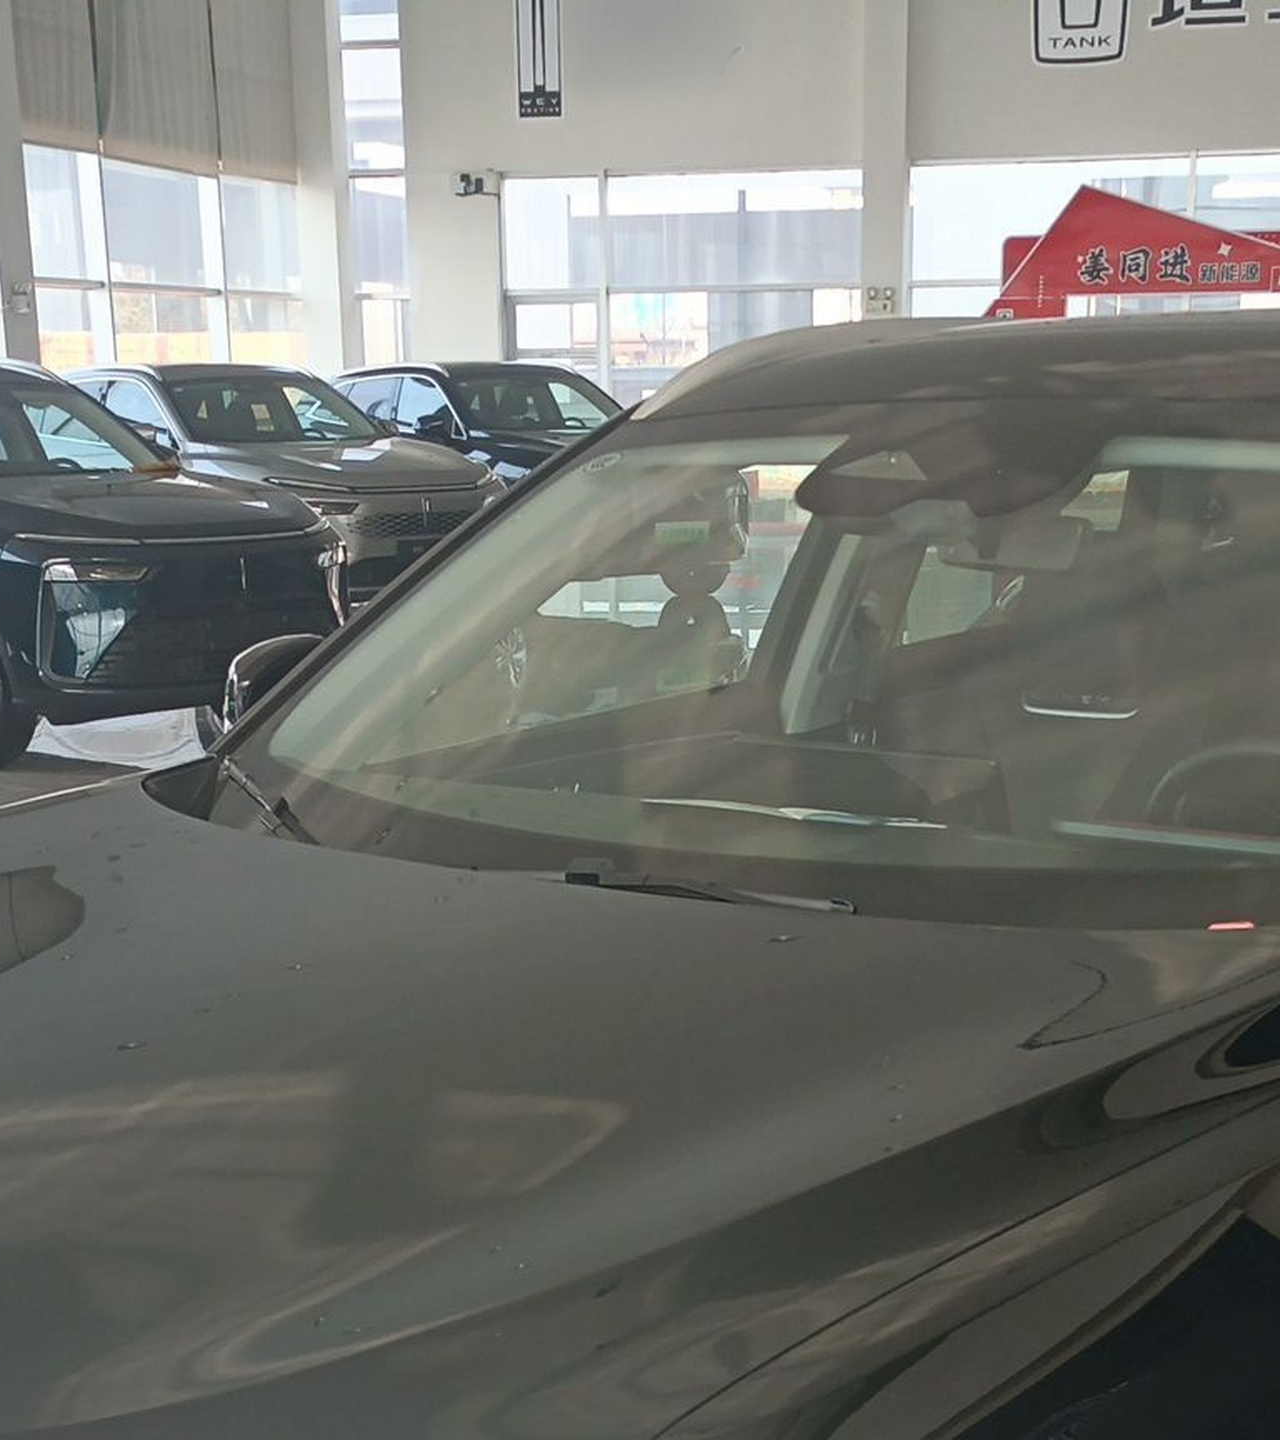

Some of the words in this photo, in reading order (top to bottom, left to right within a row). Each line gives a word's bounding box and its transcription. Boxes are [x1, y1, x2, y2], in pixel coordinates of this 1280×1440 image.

[1048, 35, 1112, 50] TANK
[521, 97, 558, 106] WEY
[1078, 242, 1192, 285] 姜同进
